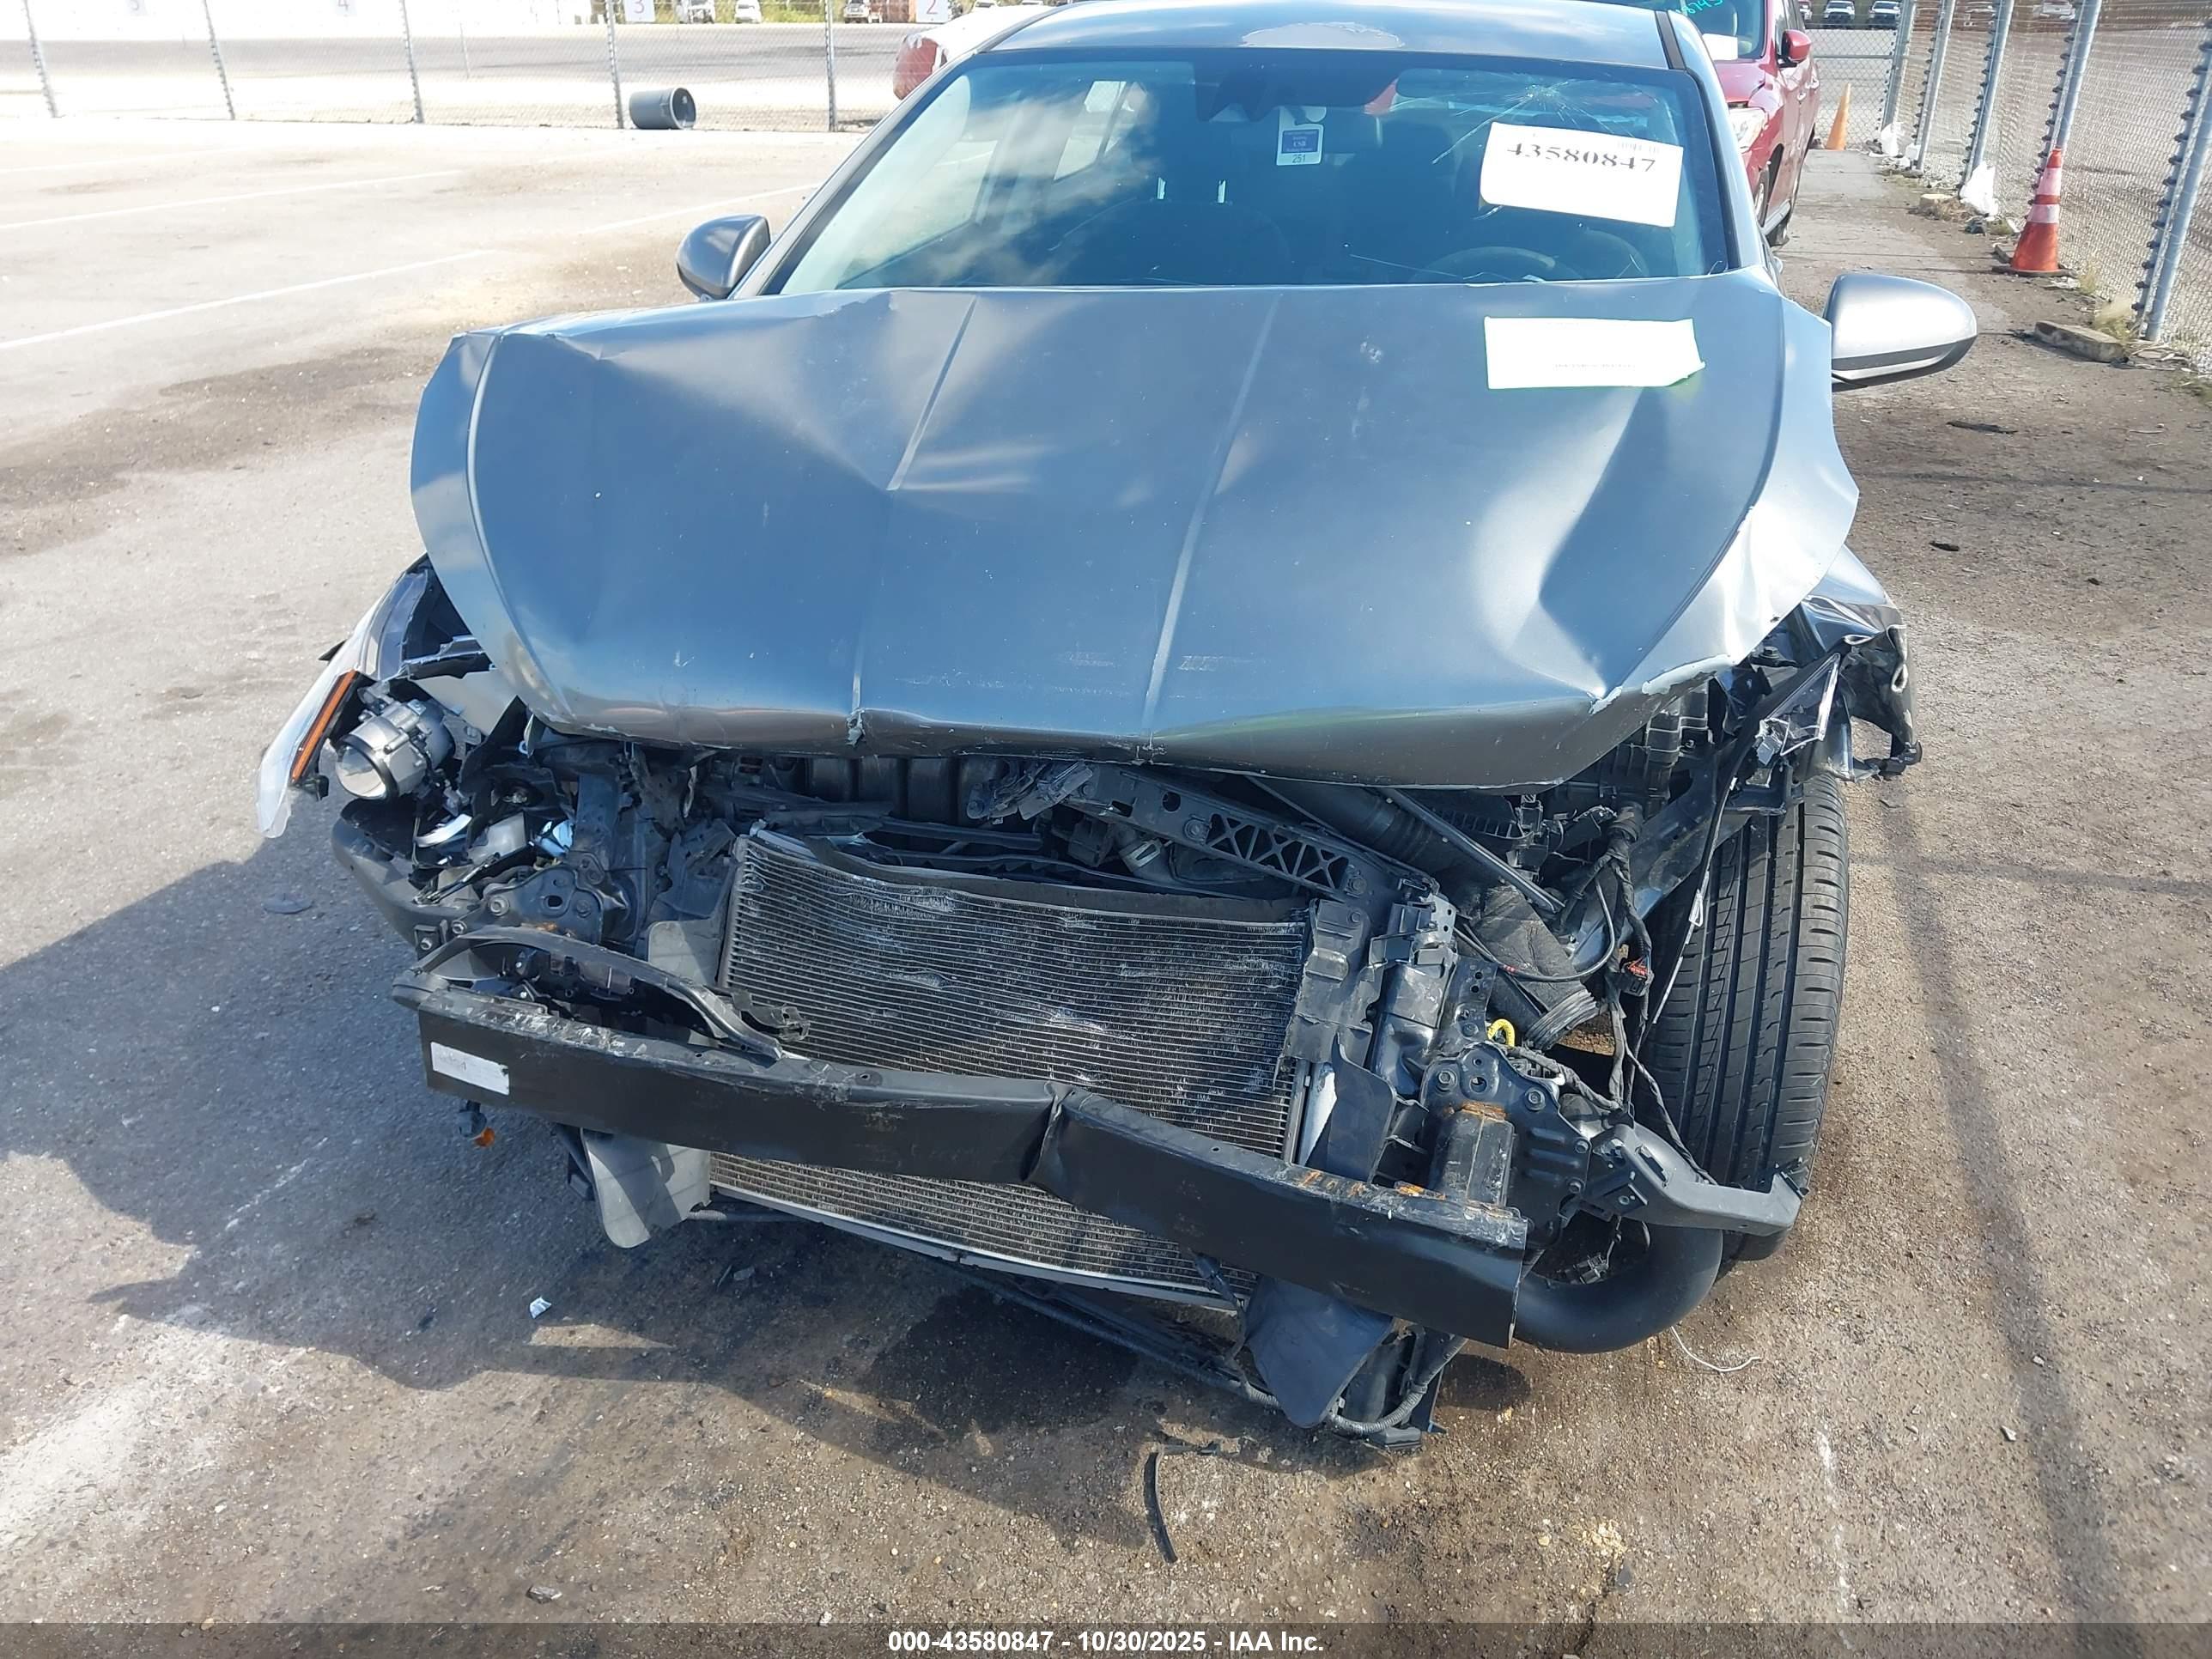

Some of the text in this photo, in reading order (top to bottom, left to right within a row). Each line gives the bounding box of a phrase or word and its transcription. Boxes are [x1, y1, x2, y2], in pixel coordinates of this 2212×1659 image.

[633, 0, 644, 14] 3
[926, 0, 938, 15] 2
[1291, 154, 1306, 164] 251
[1507, 143, 1656, 173] 43580847
